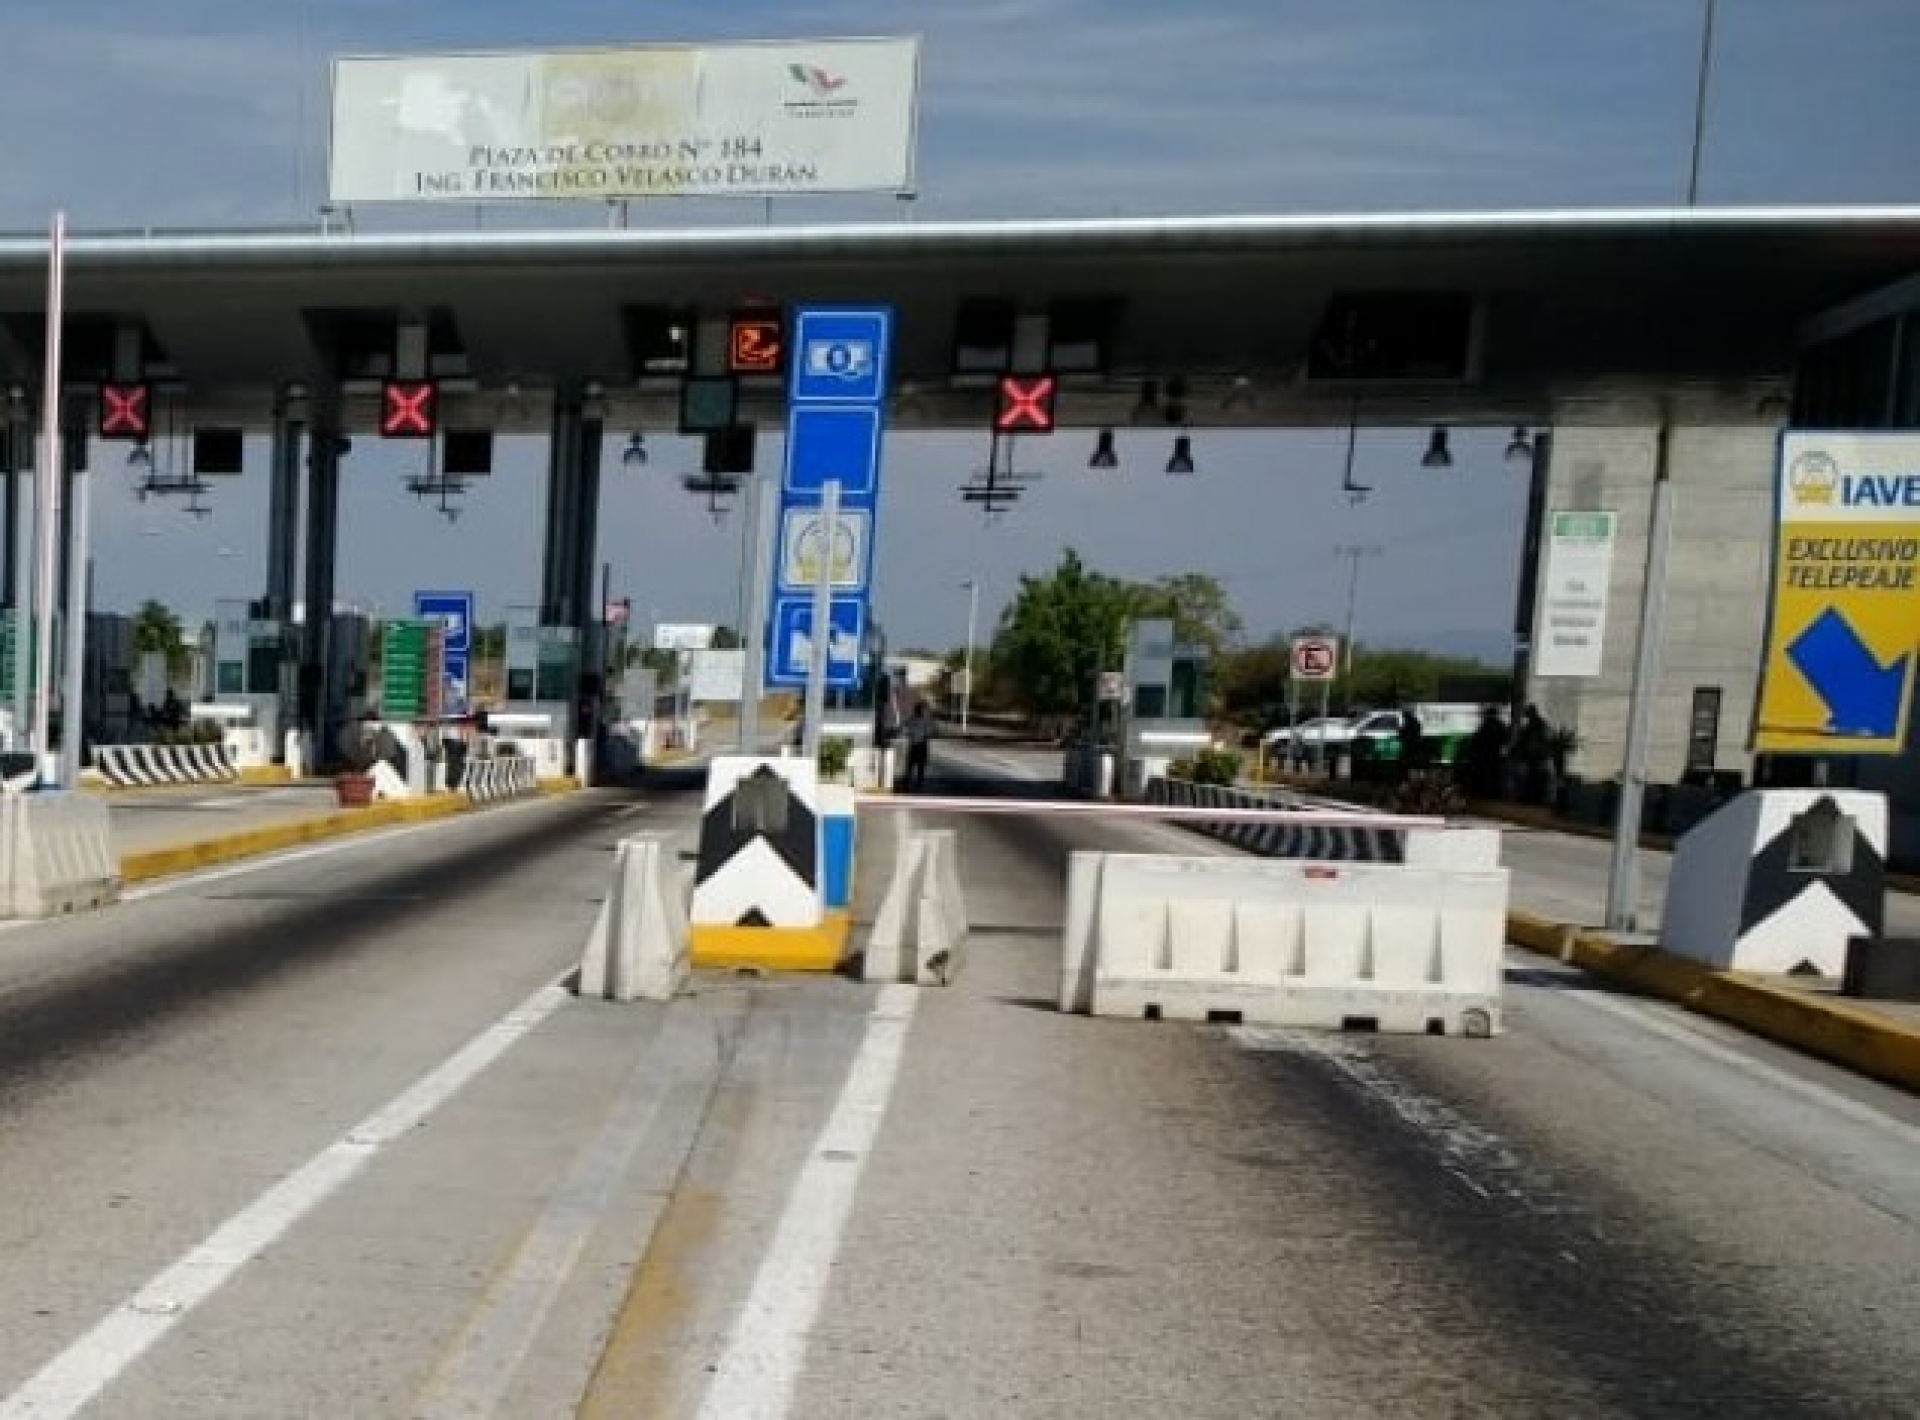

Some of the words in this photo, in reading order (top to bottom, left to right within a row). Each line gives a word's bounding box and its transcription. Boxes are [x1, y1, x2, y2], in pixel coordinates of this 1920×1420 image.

[469, 144, 538, 168] PLAZA
[547, 145, 574, 165] DE
[721, 135, 764, 159] 184
[473, 167, 608, 191] FRANCISCO
[614, 164, 722, 188] VELASCO
[1841, 474, 1920, 506] IAVE
[1788, 538, 1918, 562] EXCLUSIVO
[1787, 565, 1915, 588] TELEPEAJE
